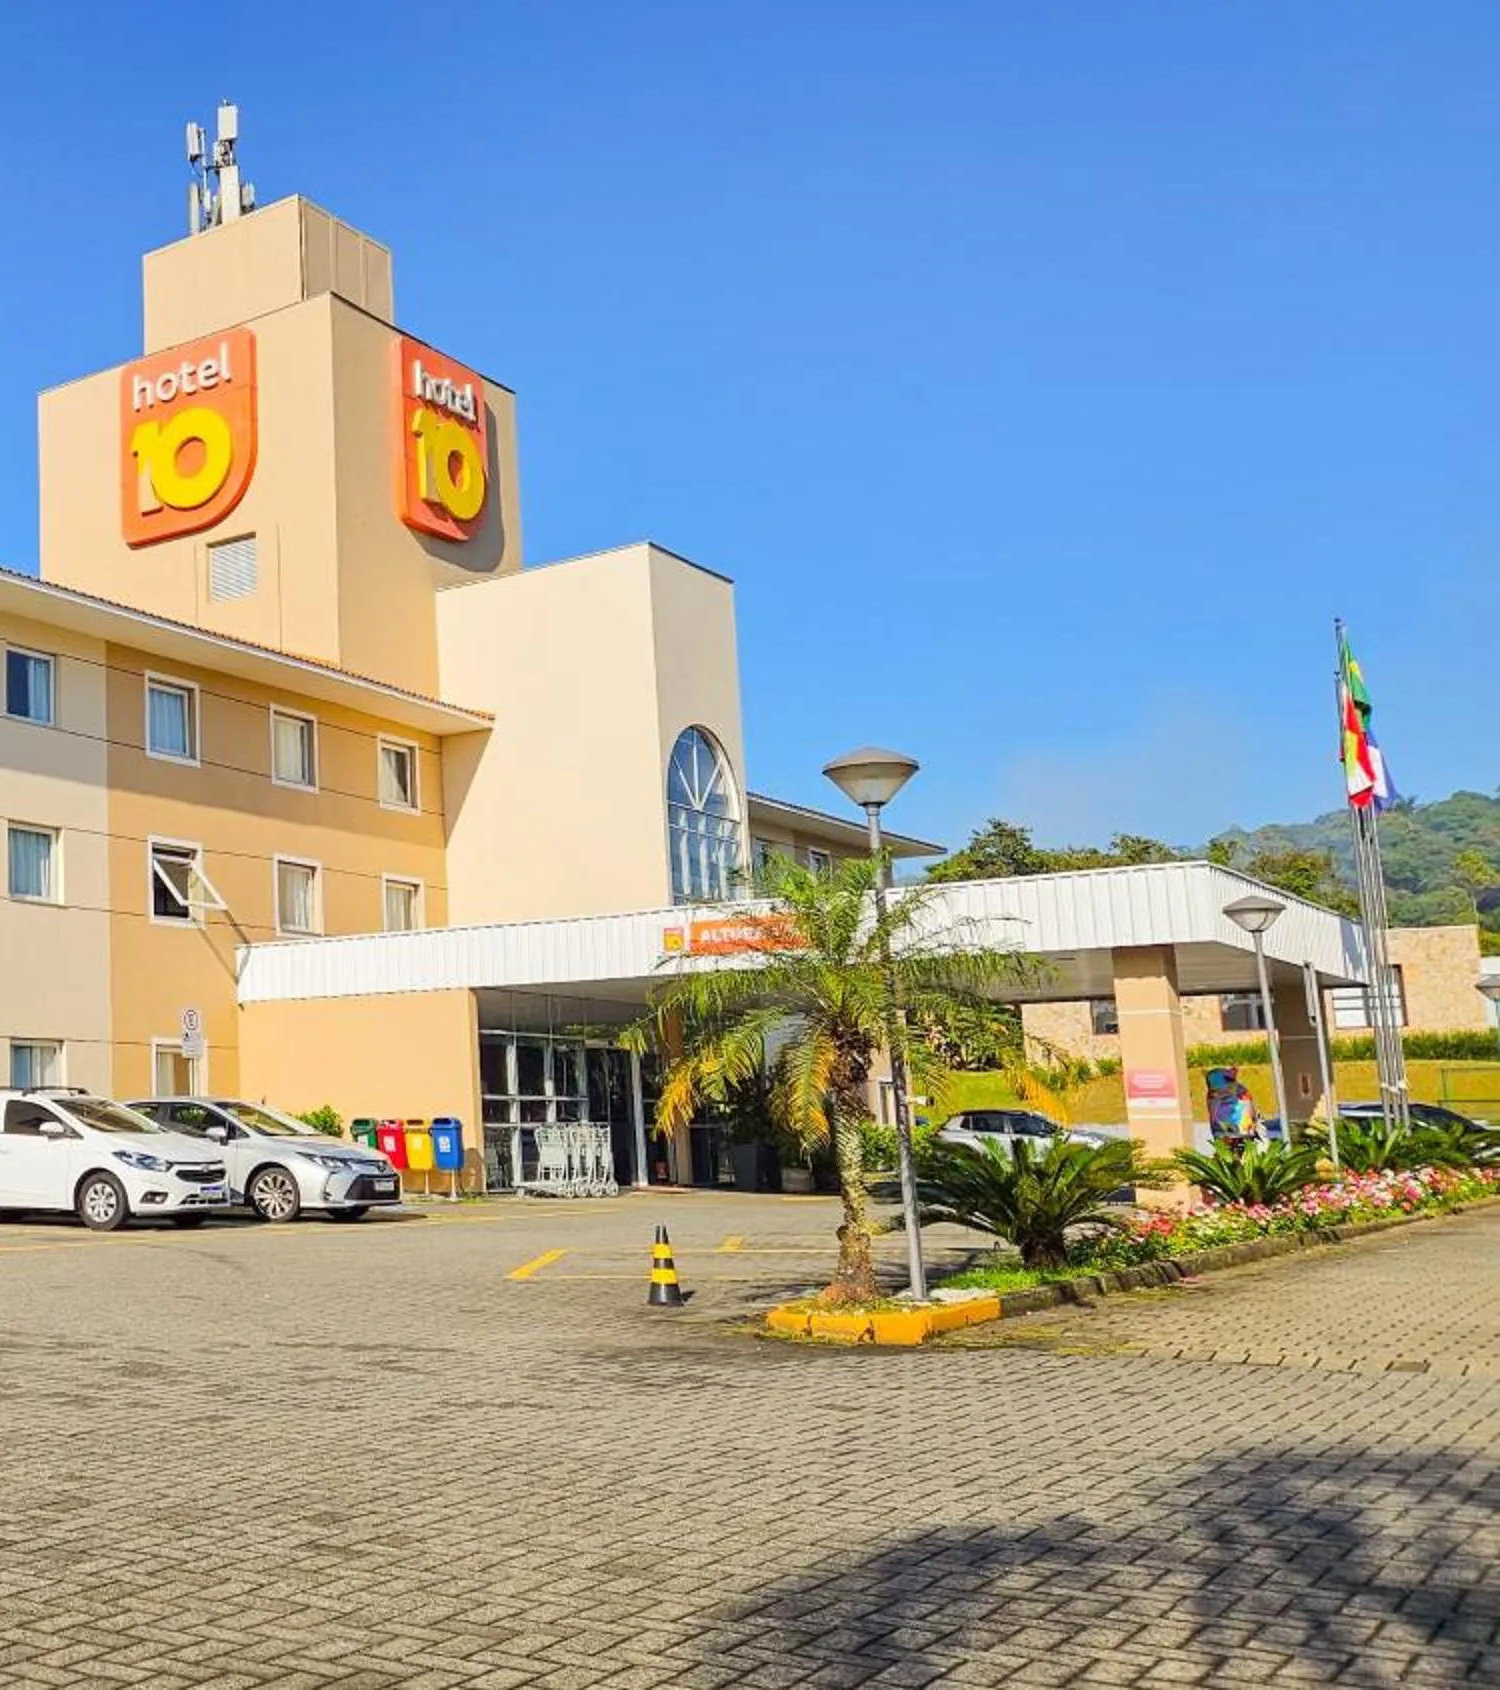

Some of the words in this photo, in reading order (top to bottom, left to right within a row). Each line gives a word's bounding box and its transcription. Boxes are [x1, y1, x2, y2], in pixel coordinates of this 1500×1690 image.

[132, 342, 231, 412] hotel
[413, 360, 477, 422] hotel
[131, 407, 233, 516] 10
[411, 407, 486, 520] 10
